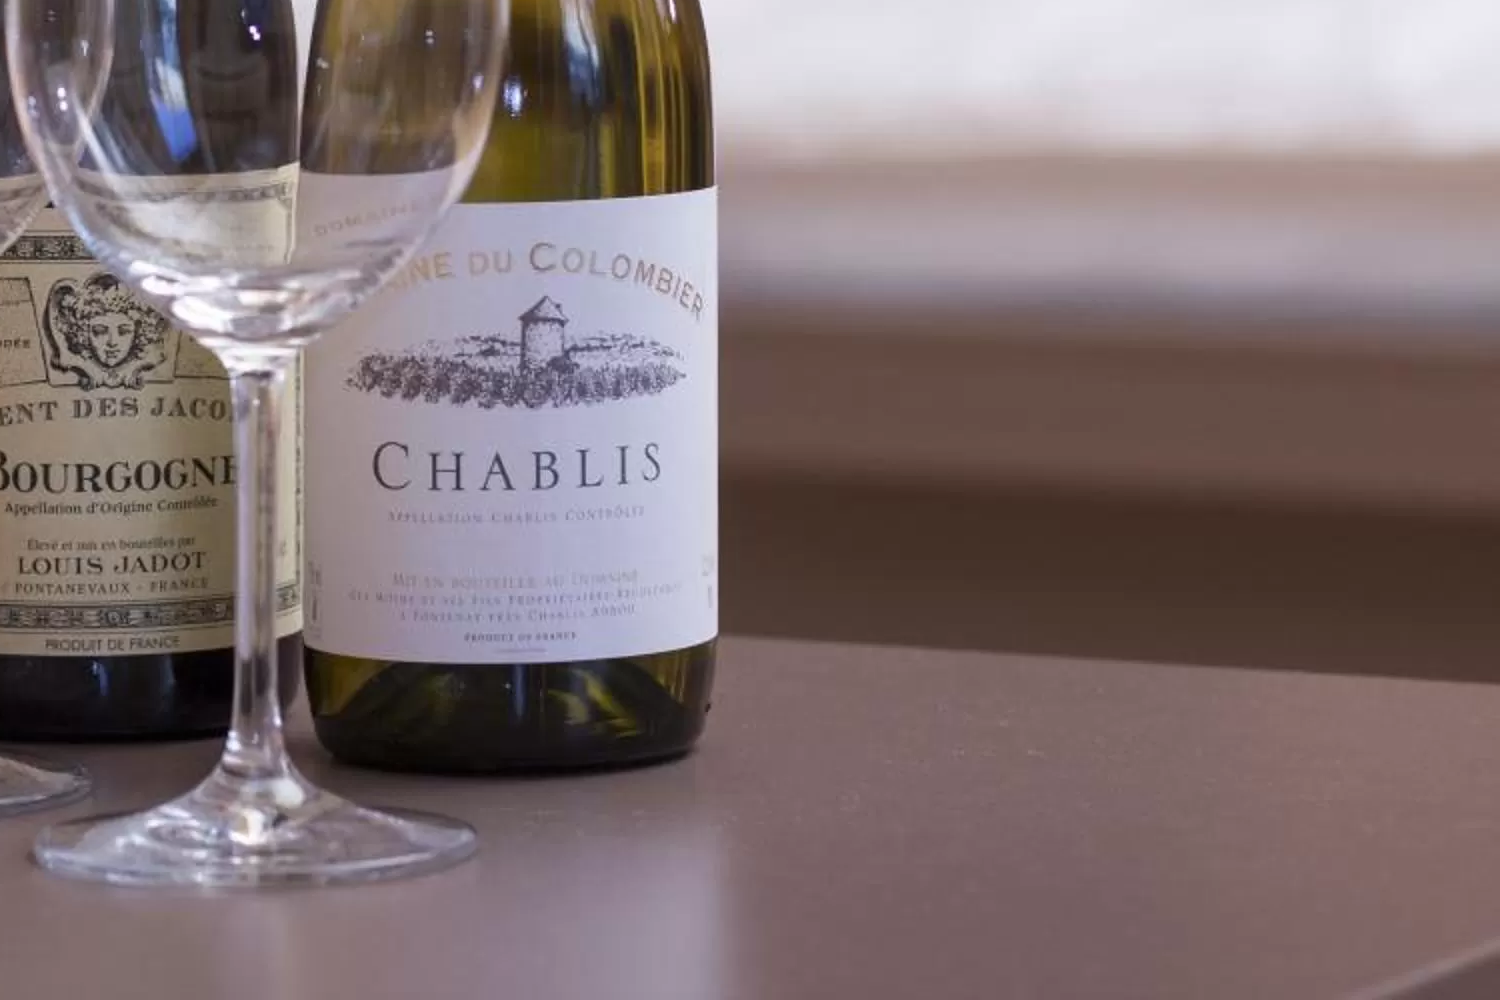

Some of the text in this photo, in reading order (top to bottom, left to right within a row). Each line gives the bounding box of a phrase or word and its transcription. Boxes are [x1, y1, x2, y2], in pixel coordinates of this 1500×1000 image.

[468, 250, 512, 278] DU
[529, 242, 705, 322] COLOMBIER
[73, 396, 140, 420] DES
[150, 397, 234, 423] JACO
[372, 441, 662, 491] CHABLIS
[4, 500, 82, 516] Appellation
[18, 552, 207, 576] LOUIS JADOT
[150, 578, 209, 594] FRANCE
[45, 636, 181, 651] PRODUIT DE FRANCE
